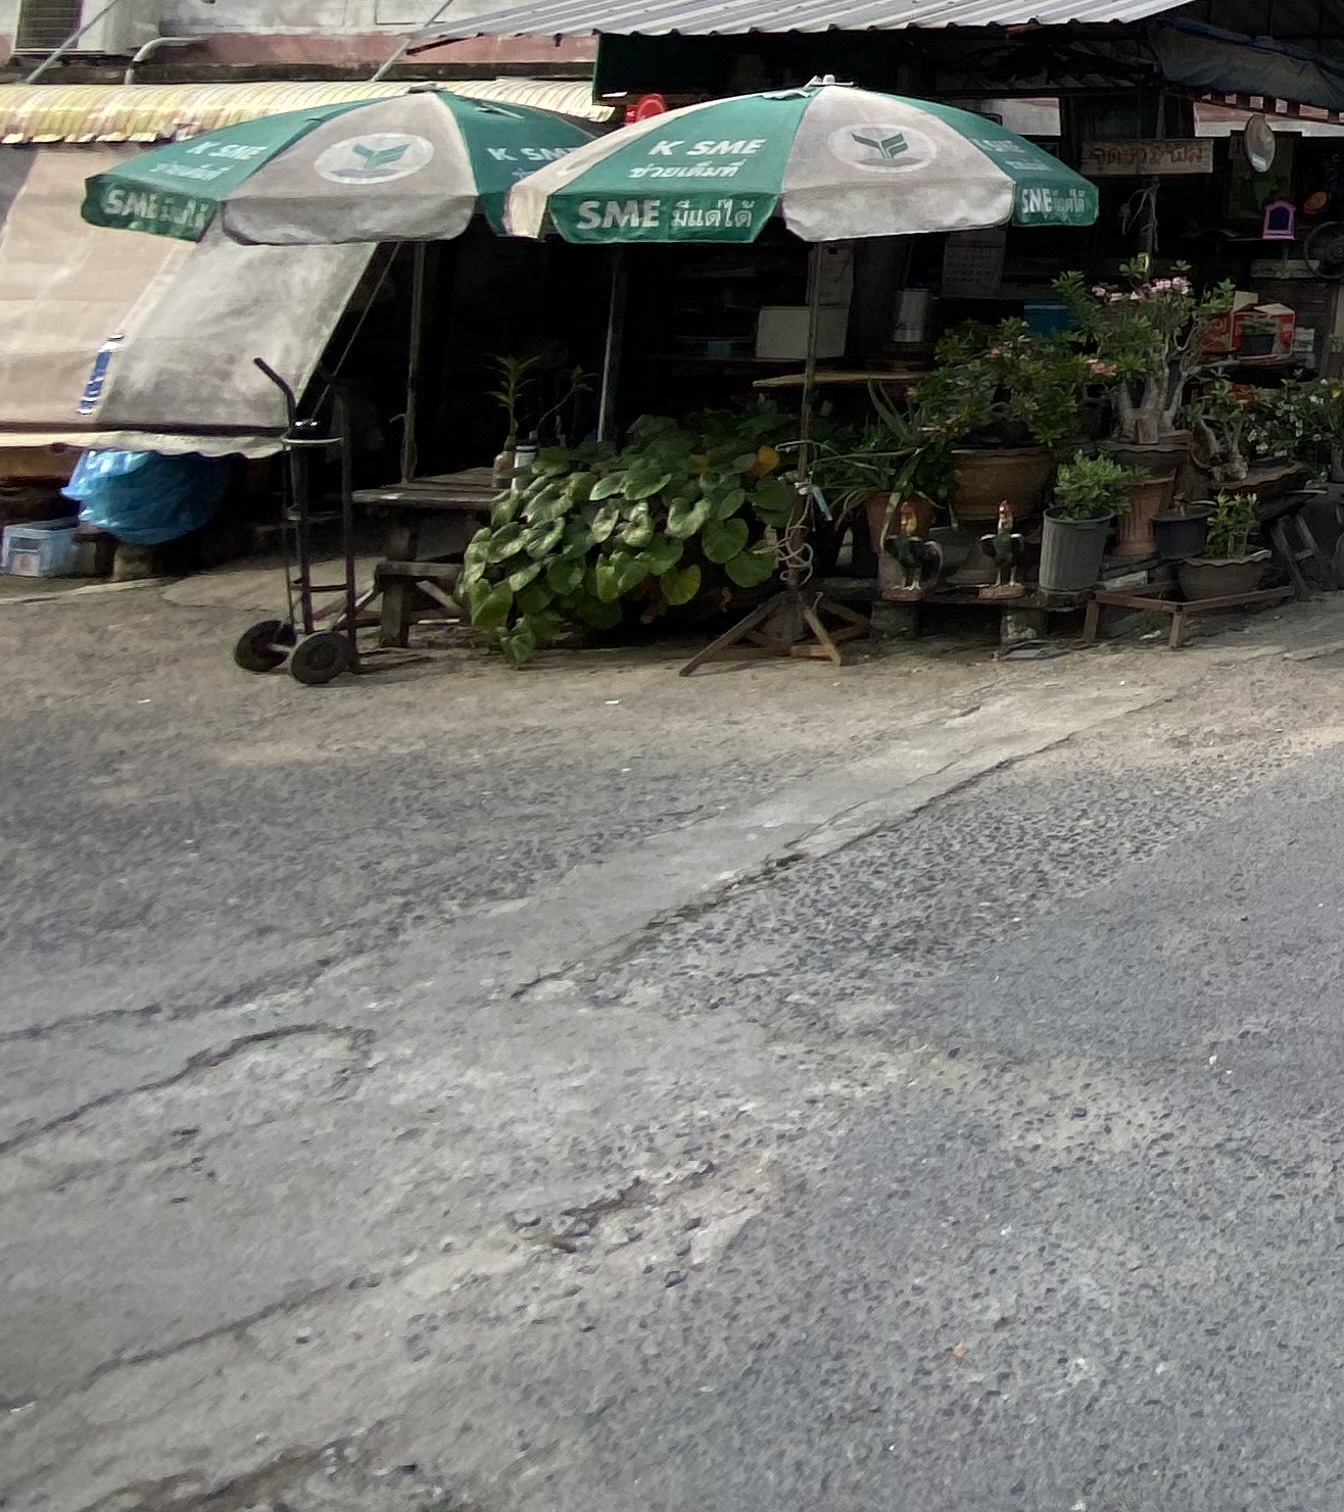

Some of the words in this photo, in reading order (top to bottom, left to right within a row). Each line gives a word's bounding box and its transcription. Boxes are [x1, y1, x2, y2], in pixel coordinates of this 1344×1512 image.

[486, 148, 518, 161] K
[648, 140, 685, 155] K
[686, 139, 767, 155] SME
[104, 190, 158, 219] SME
[576, 200, 661, 229] SME
[671, 199, 755, 228] มีแต่ได้
